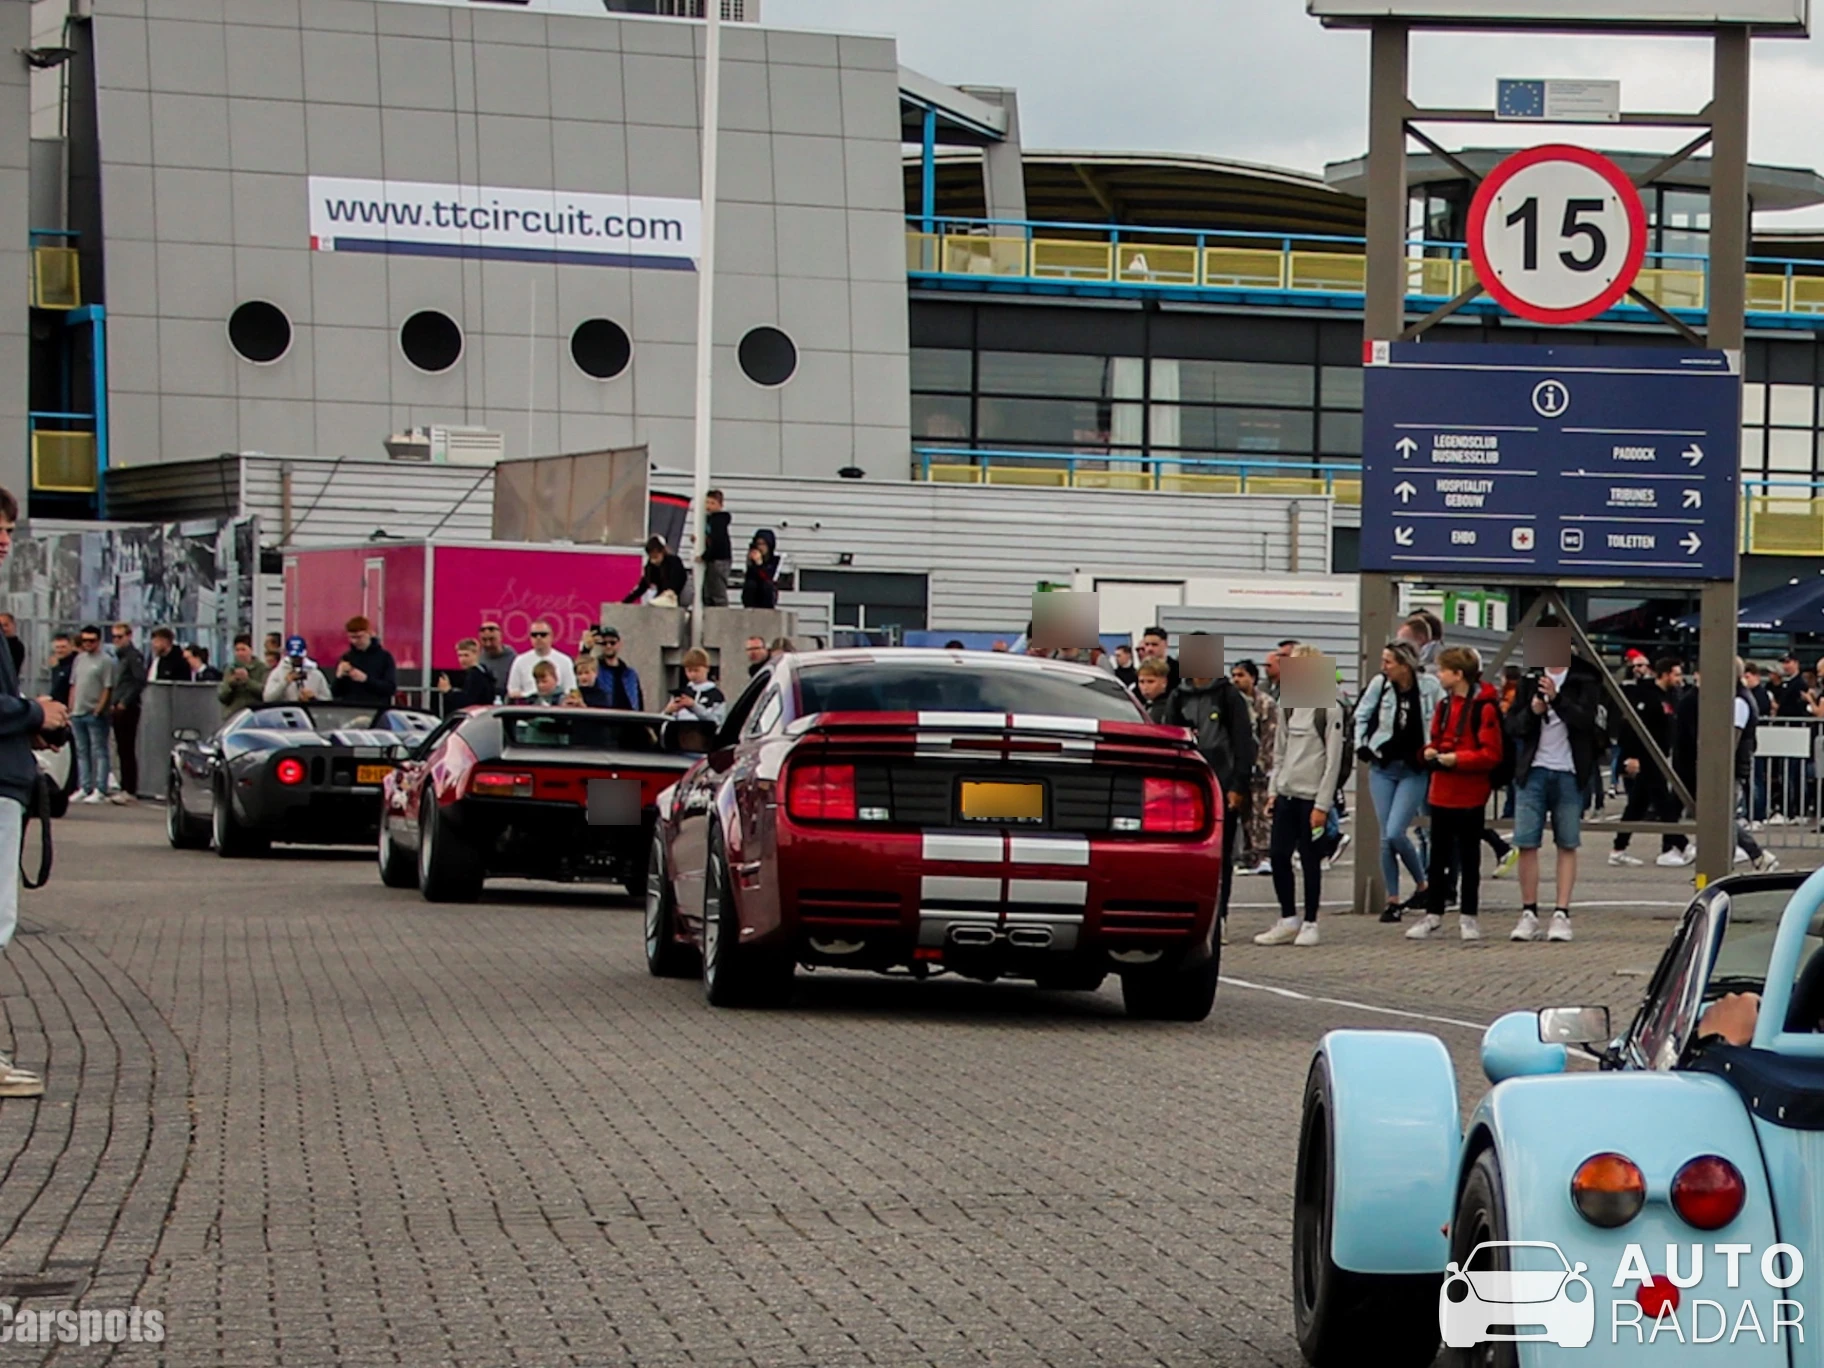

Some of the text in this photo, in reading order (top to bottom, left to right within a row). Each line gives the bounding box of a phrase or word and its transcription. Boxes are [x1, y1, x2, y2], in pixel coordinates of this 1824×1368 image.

[325, 199, 683, 241] www.ttcircuit.com
[1506, 196, 1607, 272] 15
[1433, 434, 1498, 449] LEGENDSCLUB
[1431, 449, 1500, 464] BUSINESSCLUB
[1612, 446, 1656, 461] PADDOCK
[1436, 479, 1494, 493] HOSPITALITY
[1610, 487, 1655, 501] TRIBUNES
[1564, 536, 1579, 545] WC
[1607, 534, 1655, 549] TOILETTEN
